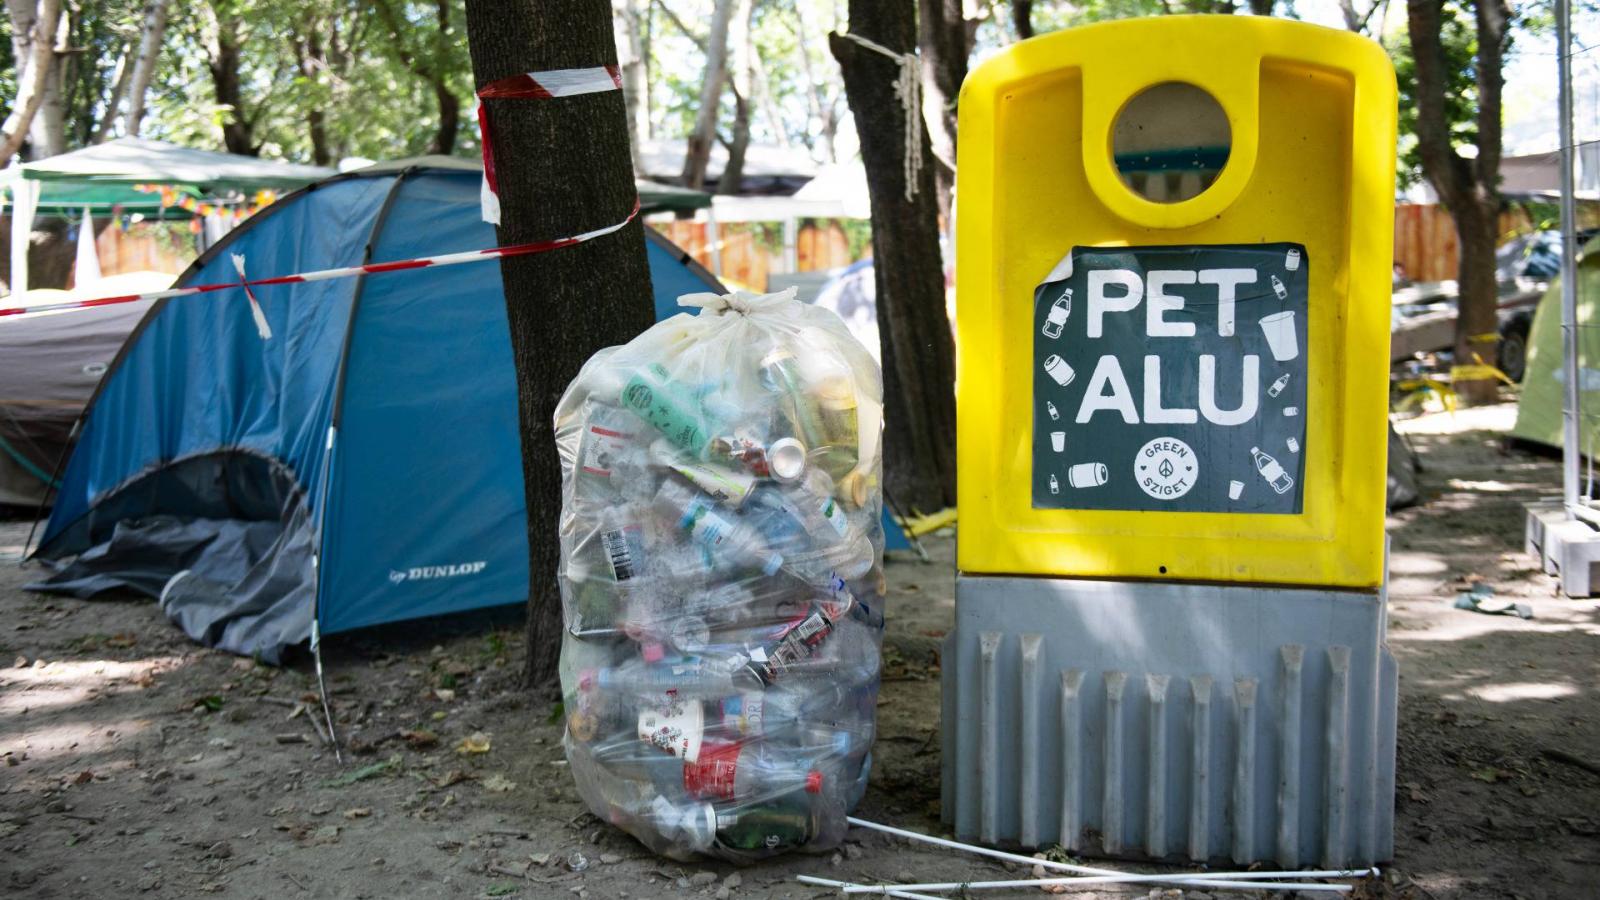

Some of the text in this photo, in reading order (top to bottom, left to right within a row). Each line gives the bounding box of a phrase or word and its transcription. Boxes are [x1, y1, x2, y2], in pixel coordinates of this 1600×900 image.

[1087, 268, 1257, 338] PET
[1075, 355, 1260, 426] ALU
[1145, 441, 1188, 458] GREEN
[1143, 477, 1188, 495] SZIGET
[408, 561, 486, 580] DUNLOP
